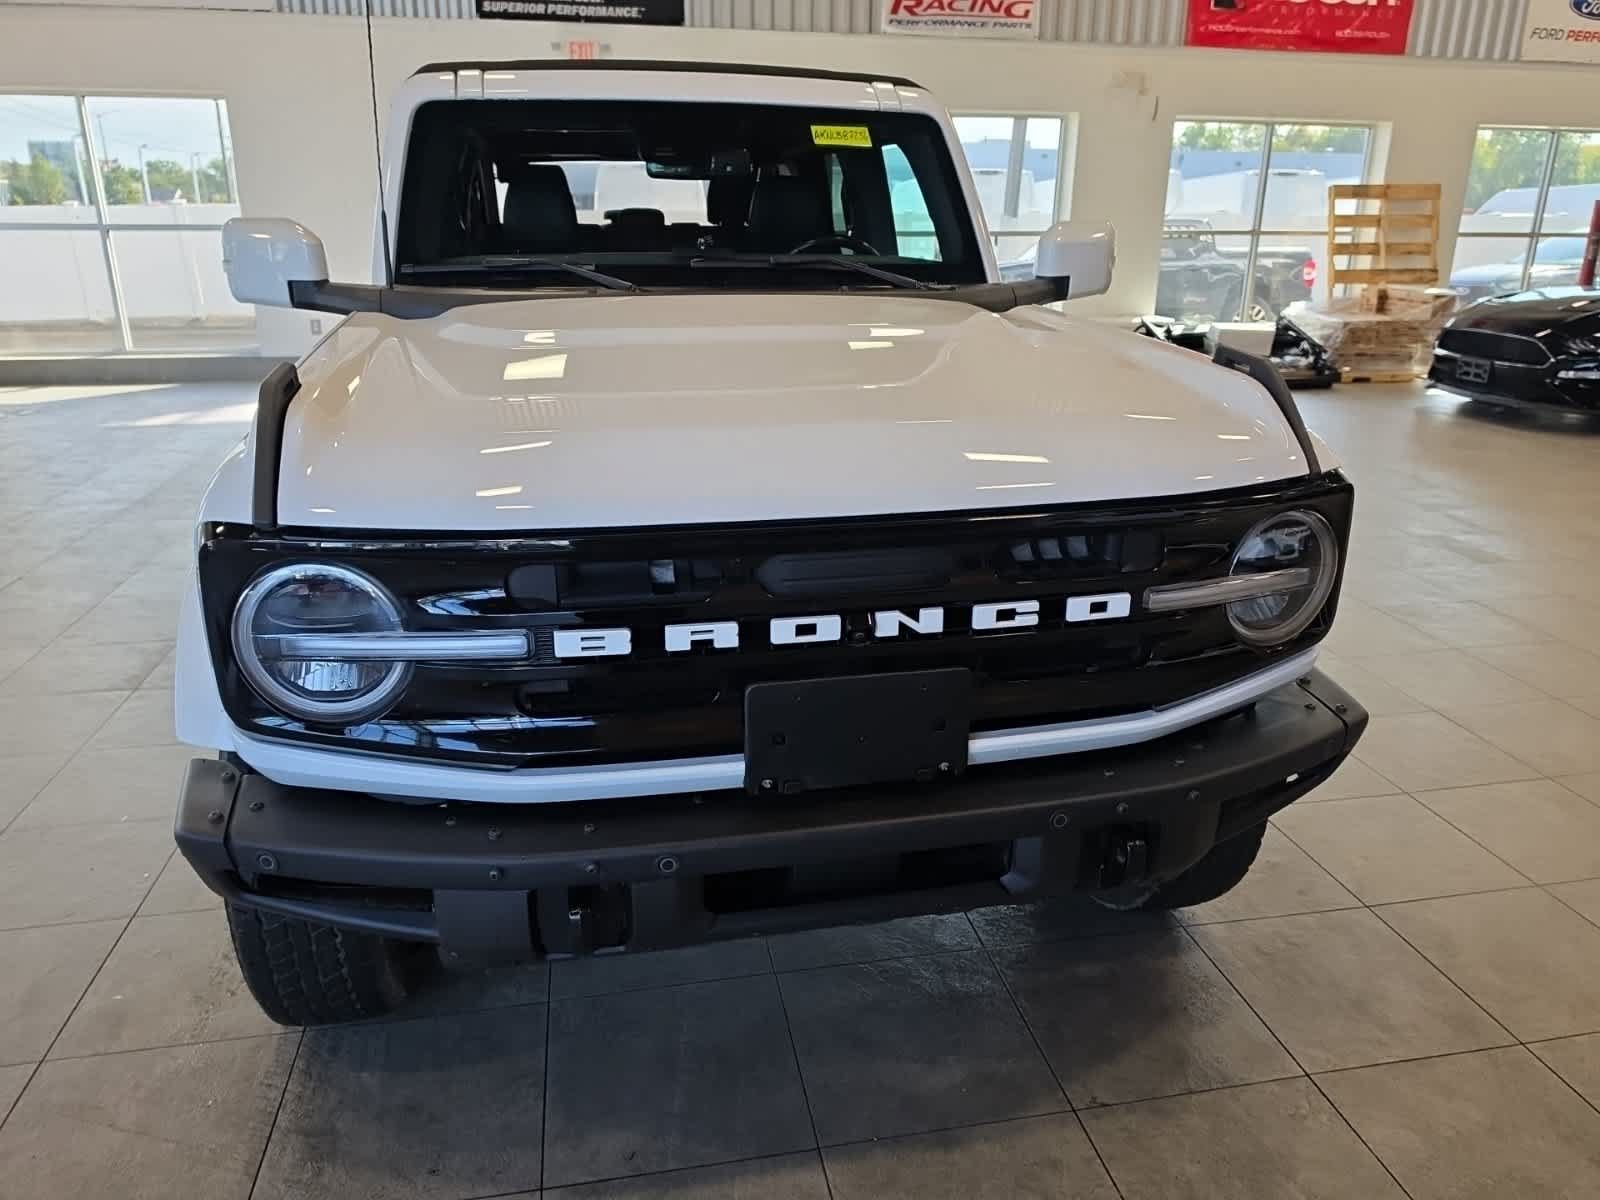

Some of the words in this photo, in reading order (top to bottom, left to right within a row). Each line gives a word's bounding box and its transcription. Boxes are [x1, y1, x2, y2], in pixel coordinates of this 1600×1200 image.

[482, 1, 546, 14] SUPERIOR
[890, 0, 1034, 18] RACING
[889, 19, 988, 28] PERFORMANCE
[991, 21, 1032, 29] PARTS
[1530, 27, 1567, 41] FORD
[568, 41, 594, 60] EXIT
[553, 592, 1132, 659] BRONCO
